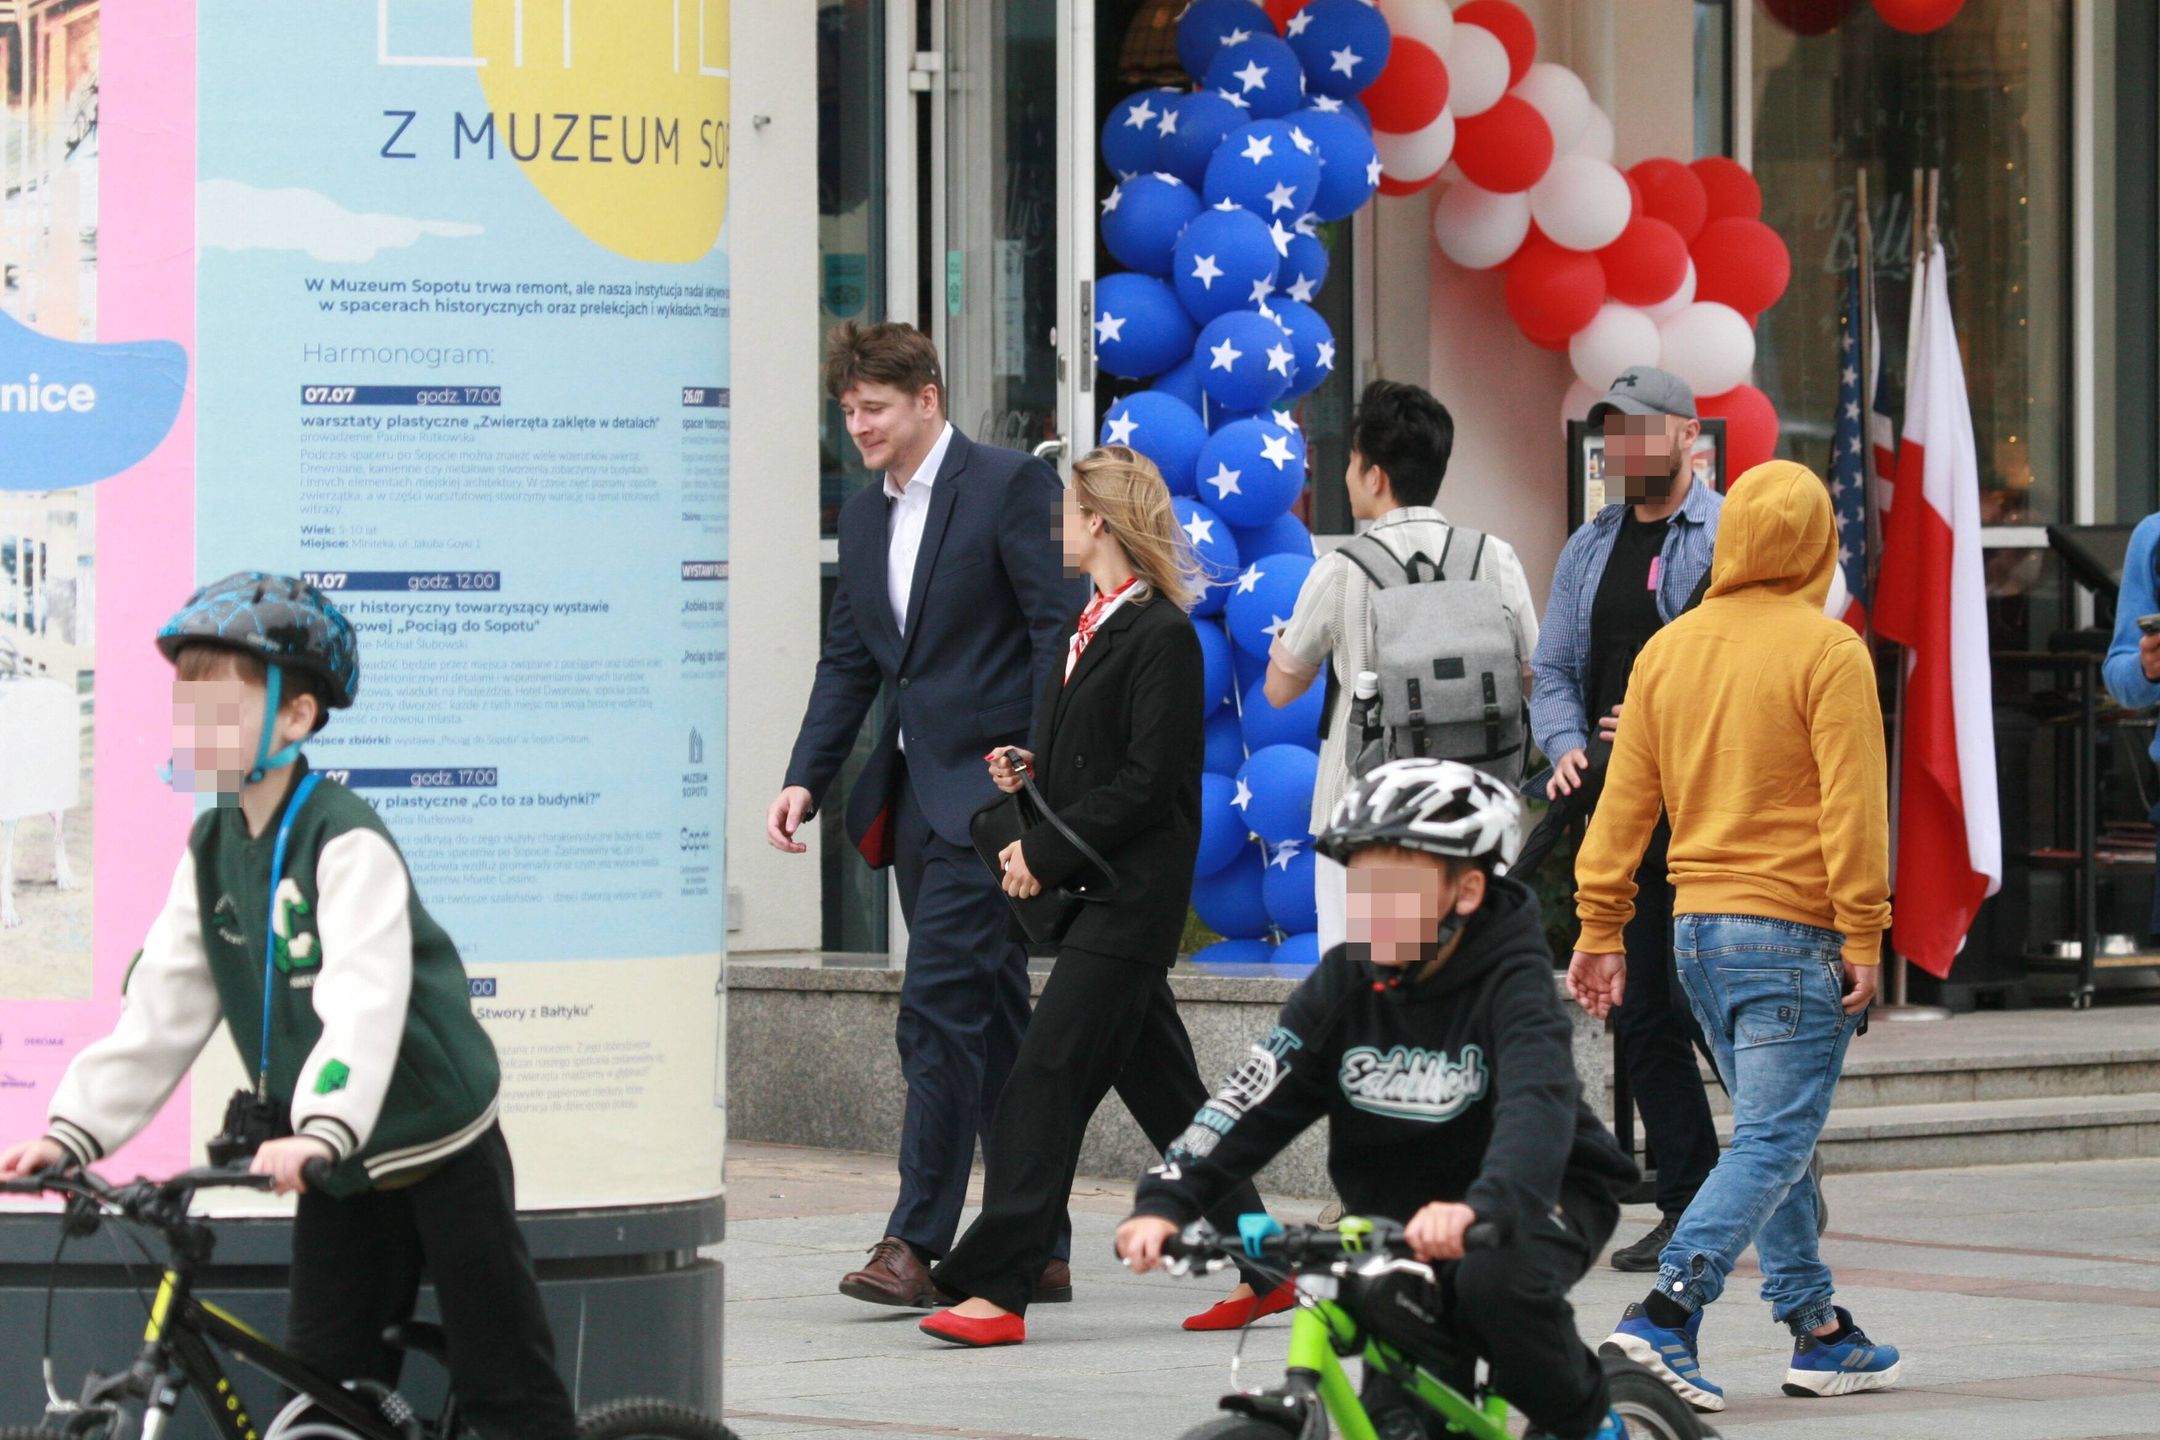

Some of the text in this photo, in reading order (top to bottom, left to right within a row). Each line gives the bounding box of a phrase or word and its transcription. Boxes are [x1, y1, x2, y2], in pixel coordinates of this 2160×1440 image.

[380, 110, 730, 169] Z MUZEUM SO
[304, 278, 325, 292] W
[330, 278, 406, 292] Muzeum
[412, 279, 471, 296] Sopotu
[476, 281, 511, 294] trwa
[516, 282, 572, 297] remont,
[576, 281, 594, 295] ale
[599, 284, 632, 296] nasza
[635, 282, 682, 300] instytucja
[319, 301, 334, 311] w
[340, 299, 430, 314] spacerach
[436, 299, 543, 316] historycznych
[547, 303, 576, 314] oraz
[580, 301, 648, 317] prelekcjach
[303, 343, 496, 369] Harmonogram:
[0, 373, 96, 413] nice
[305, 387, 501, 406] 07.07 godz. 17.00
[300, 416, 382, 429] warsztaty
[387, 415, 468, 429] plastyczne
[552, 415, 597, 431] zaklęte
[599, 417, 610, 428] w
[304, 573, 495, 591] 11.07 godz. 12.00
[361, 600, 451, 616] historyczny
[455, 602, 549, 616] towarzyszący
[553, 601, 610, 614] wystawie
[398, 620, 457, 635] „Pociąg
[462, 620, 481, 632] do
[410, 770, 454, 788] godz.
[458, 769, 496, 786] 17.00
[386, 795, 467, 810] plastyczne
[472, 794, 498, 809] „Co
[501, 795, 516, 807] to
[519, 796, 534, 807] za
[530, 1009, 537, 1018] z
